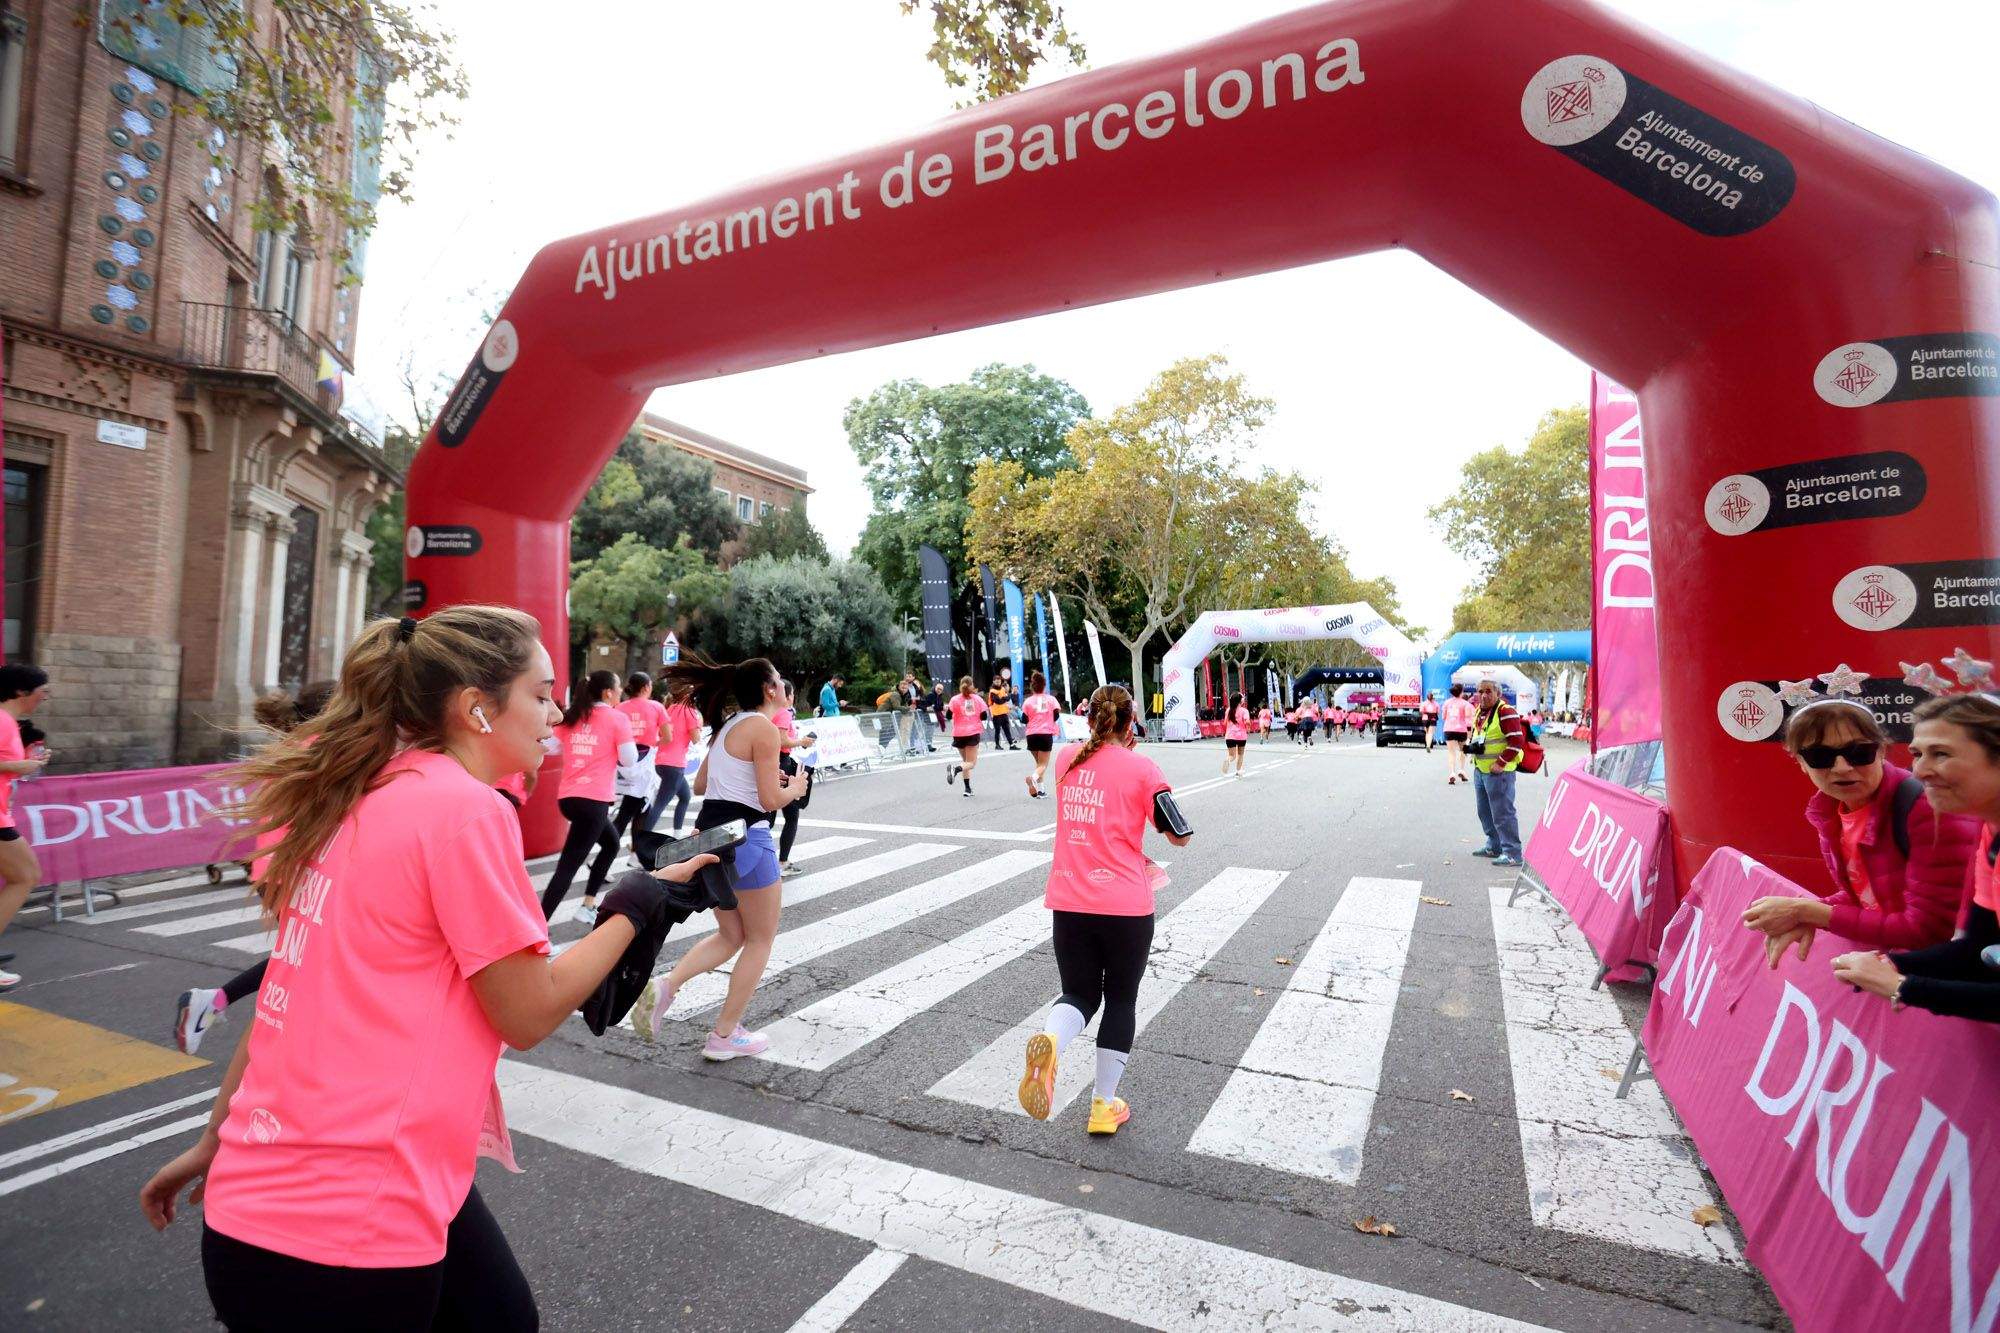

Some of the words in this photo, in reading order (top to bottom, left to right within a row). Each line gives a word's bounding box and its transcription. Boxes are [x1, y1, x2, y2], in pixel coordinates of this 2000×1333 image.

[1636, 110, 1741, 171] Ajuntament
[1738, 164, 1764, 183] de
[574, 170, 861, 299] Ajuntament
[878, 149, 954, 208] de
[973, 36, 1366, 185] Barcelona
[1615, 126, 1743, 210] Barcelona
[1910, 347, 1985, 363] Ajuntament
[1985, 347, 1996, 359] de
[1910, 361, 1998, 381] Barcelona
[1785, 469, 1877, 492] Ajuntament
[1880, 466, 1900, 478] de
[1785, 484, 1901, 508] Barcelona
[1213, 625, 1240, 638] COSMO
[1326, 614, 1354, 632] COSMO
[1894, 693, 1914, 705] de
[1077, 768, 1096, 786] TU
[1062, 785, 1105, 808] DORSAL
[1063, 804, 1096, 825] SUMA
